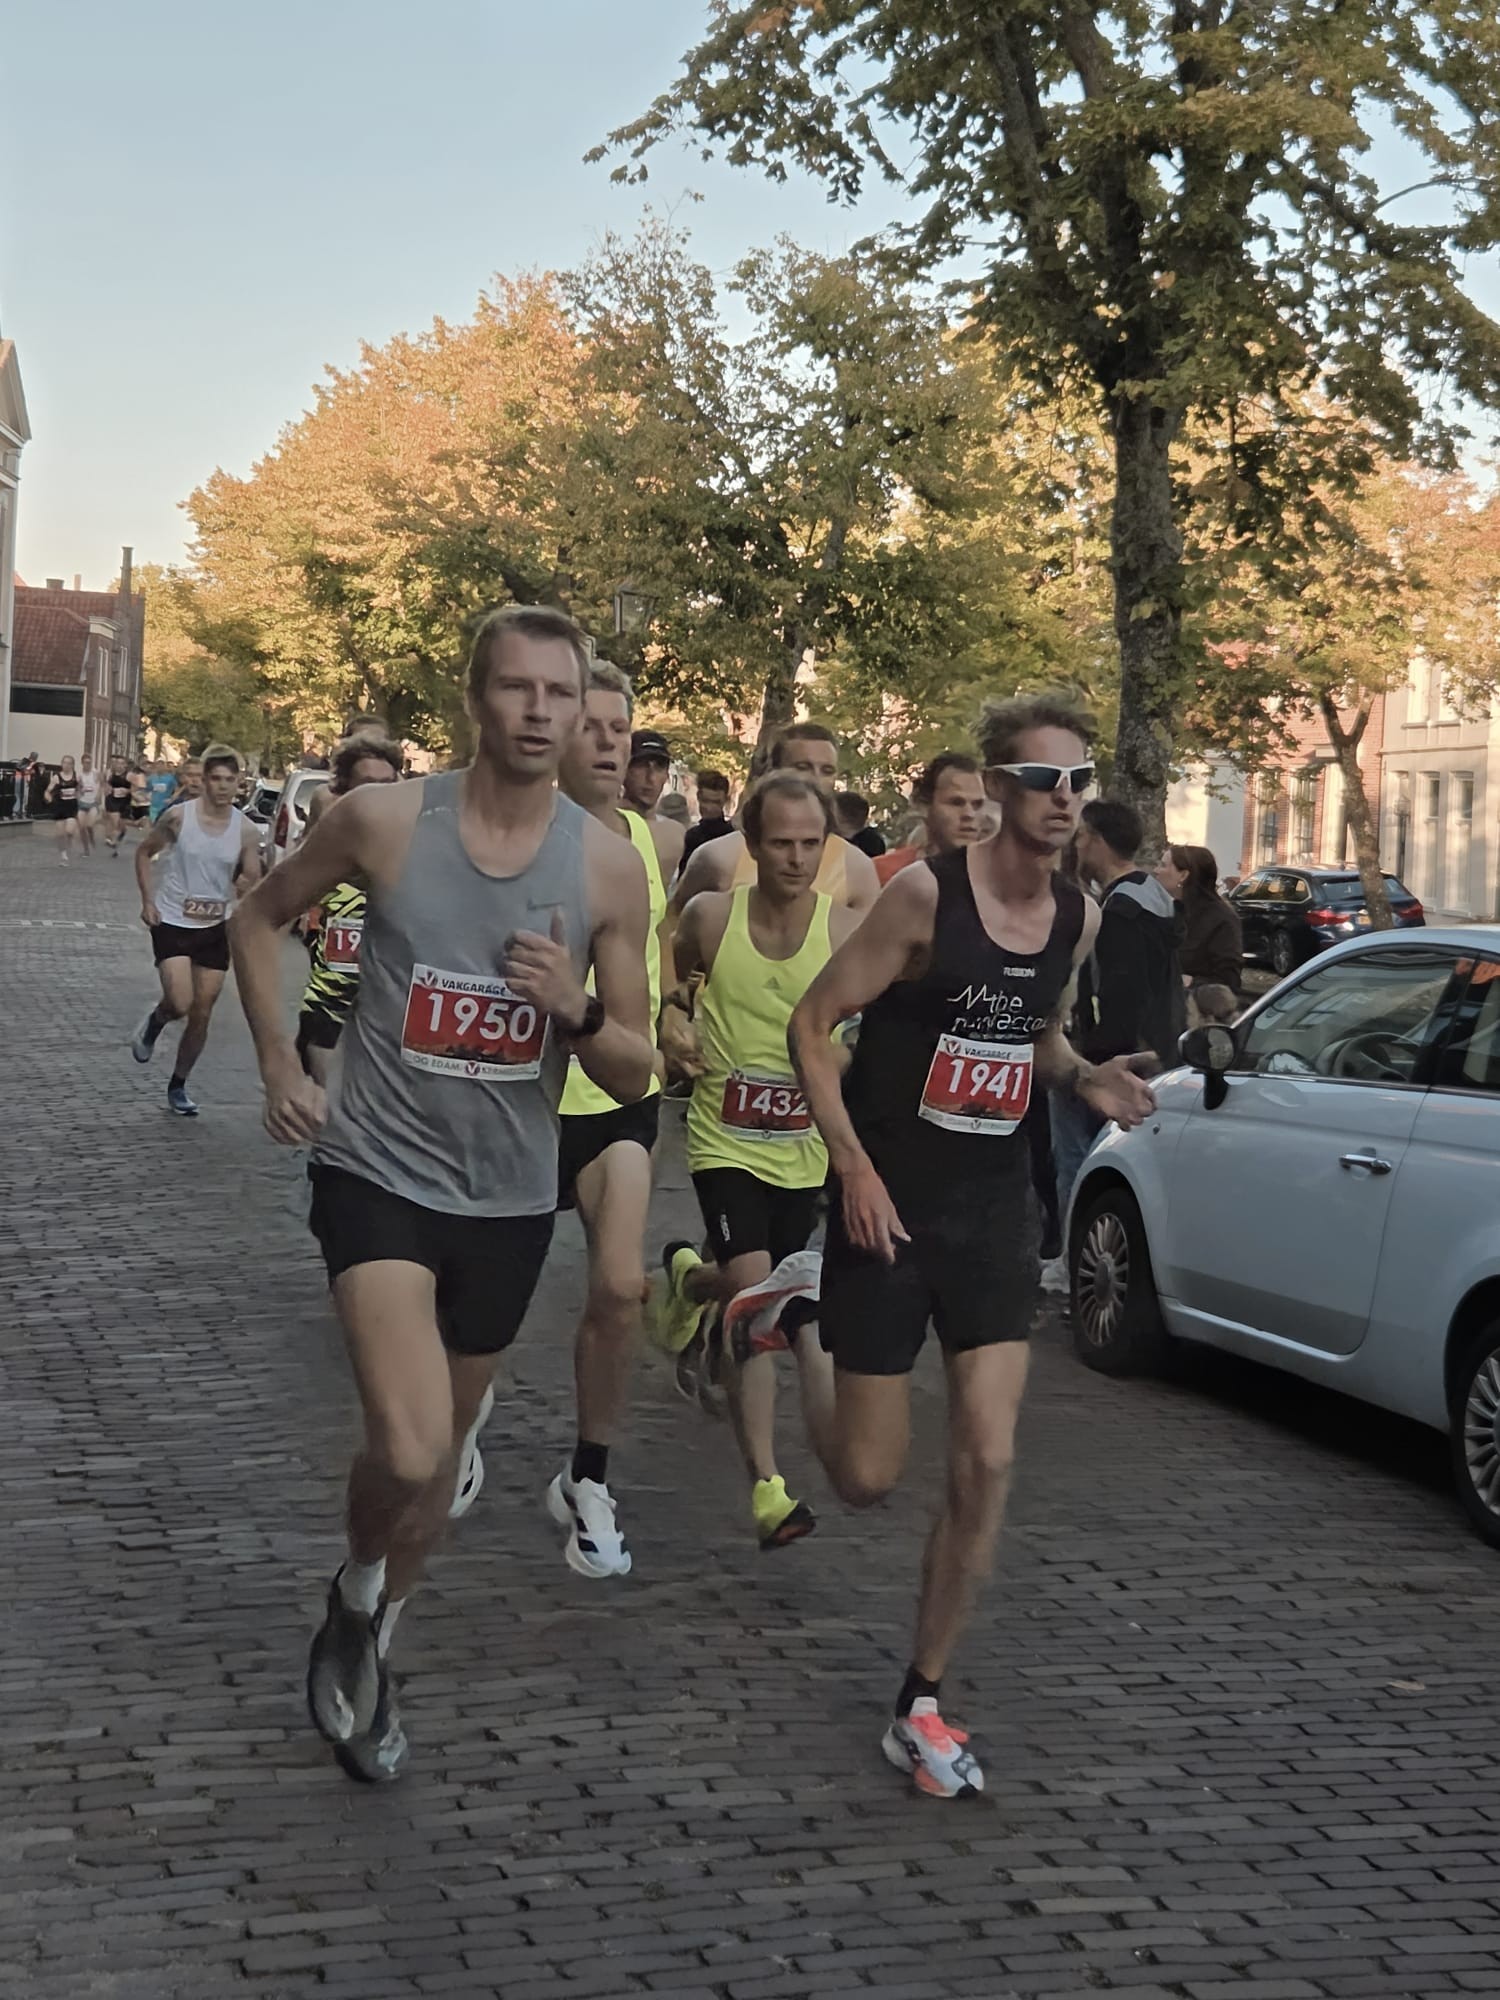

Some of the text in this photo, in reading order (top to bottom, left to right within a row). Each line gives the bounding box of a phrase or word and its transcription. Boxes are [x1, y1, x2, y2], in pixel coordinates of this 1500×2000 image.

[428, 992, 537, 1043] 1950
[737, 1084, 808, 1116] 1432
[948, 1058, 1025, 1101] 1941
